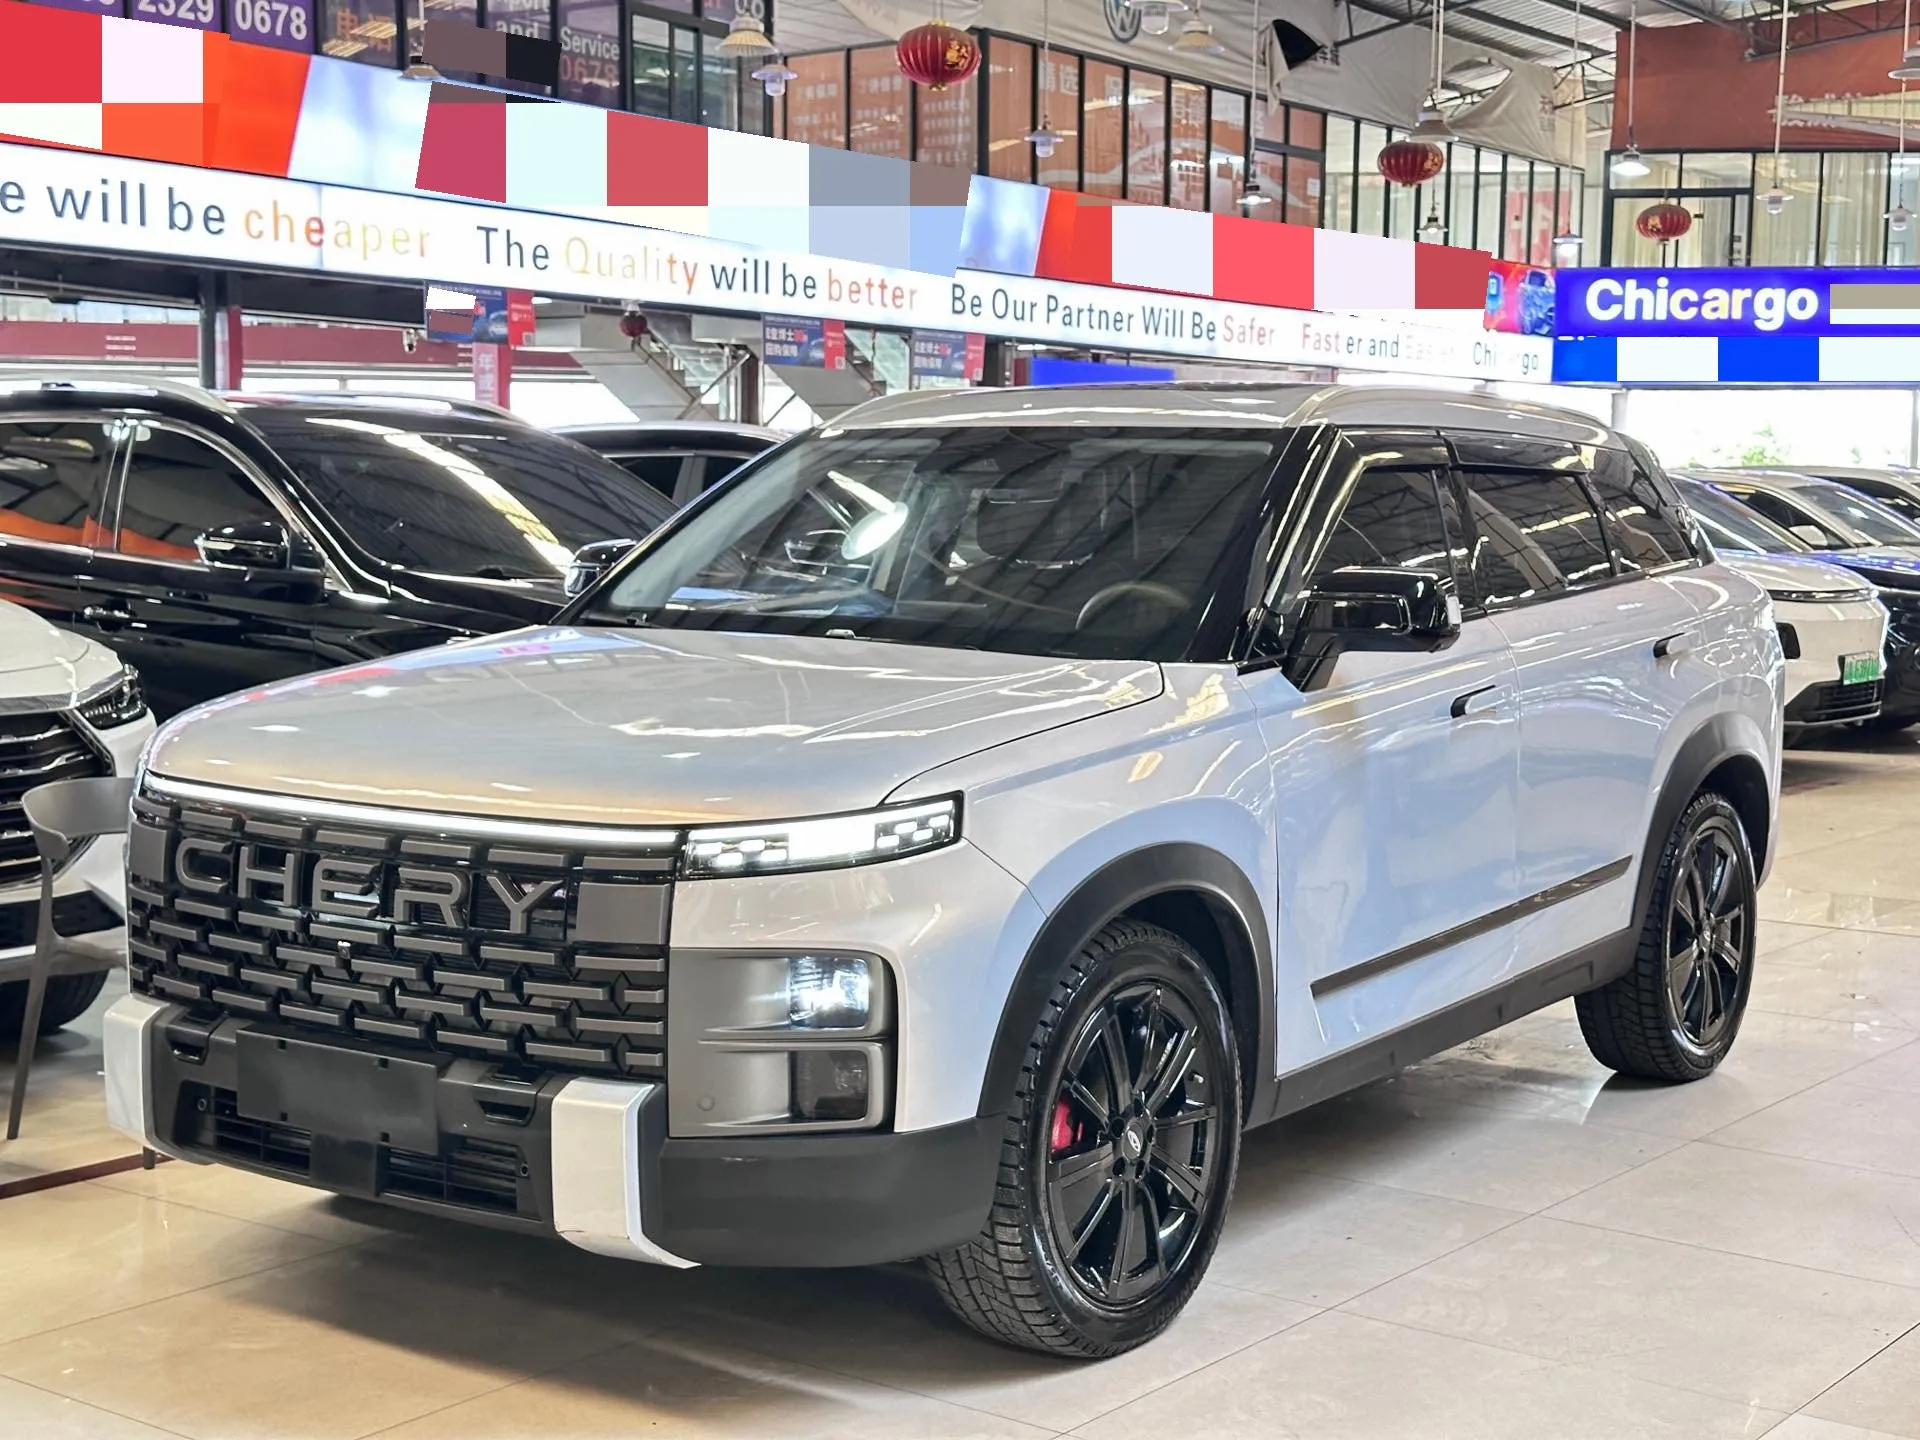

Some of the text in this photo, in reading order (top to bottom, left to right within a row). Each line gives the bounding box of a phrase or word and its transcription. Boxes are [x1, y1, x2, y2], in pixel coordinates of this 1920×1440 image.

[234, 0, 307, 40] 0678
[560, 26, 620, 60] Service
[46, 178, 147, 227] will
[168, 186, 226, 236] be
[244, 199, 430, 261] cheaper
[476, 225, 918, 310] The Quality will be better
[951, 283, 1275, 346] Be Our Partner Will Be Safer
[1585, 276, 1819, 331] Chicargo
[1368, 334, 1399, 358] and
[175, 837, 564, 934] CHERY
